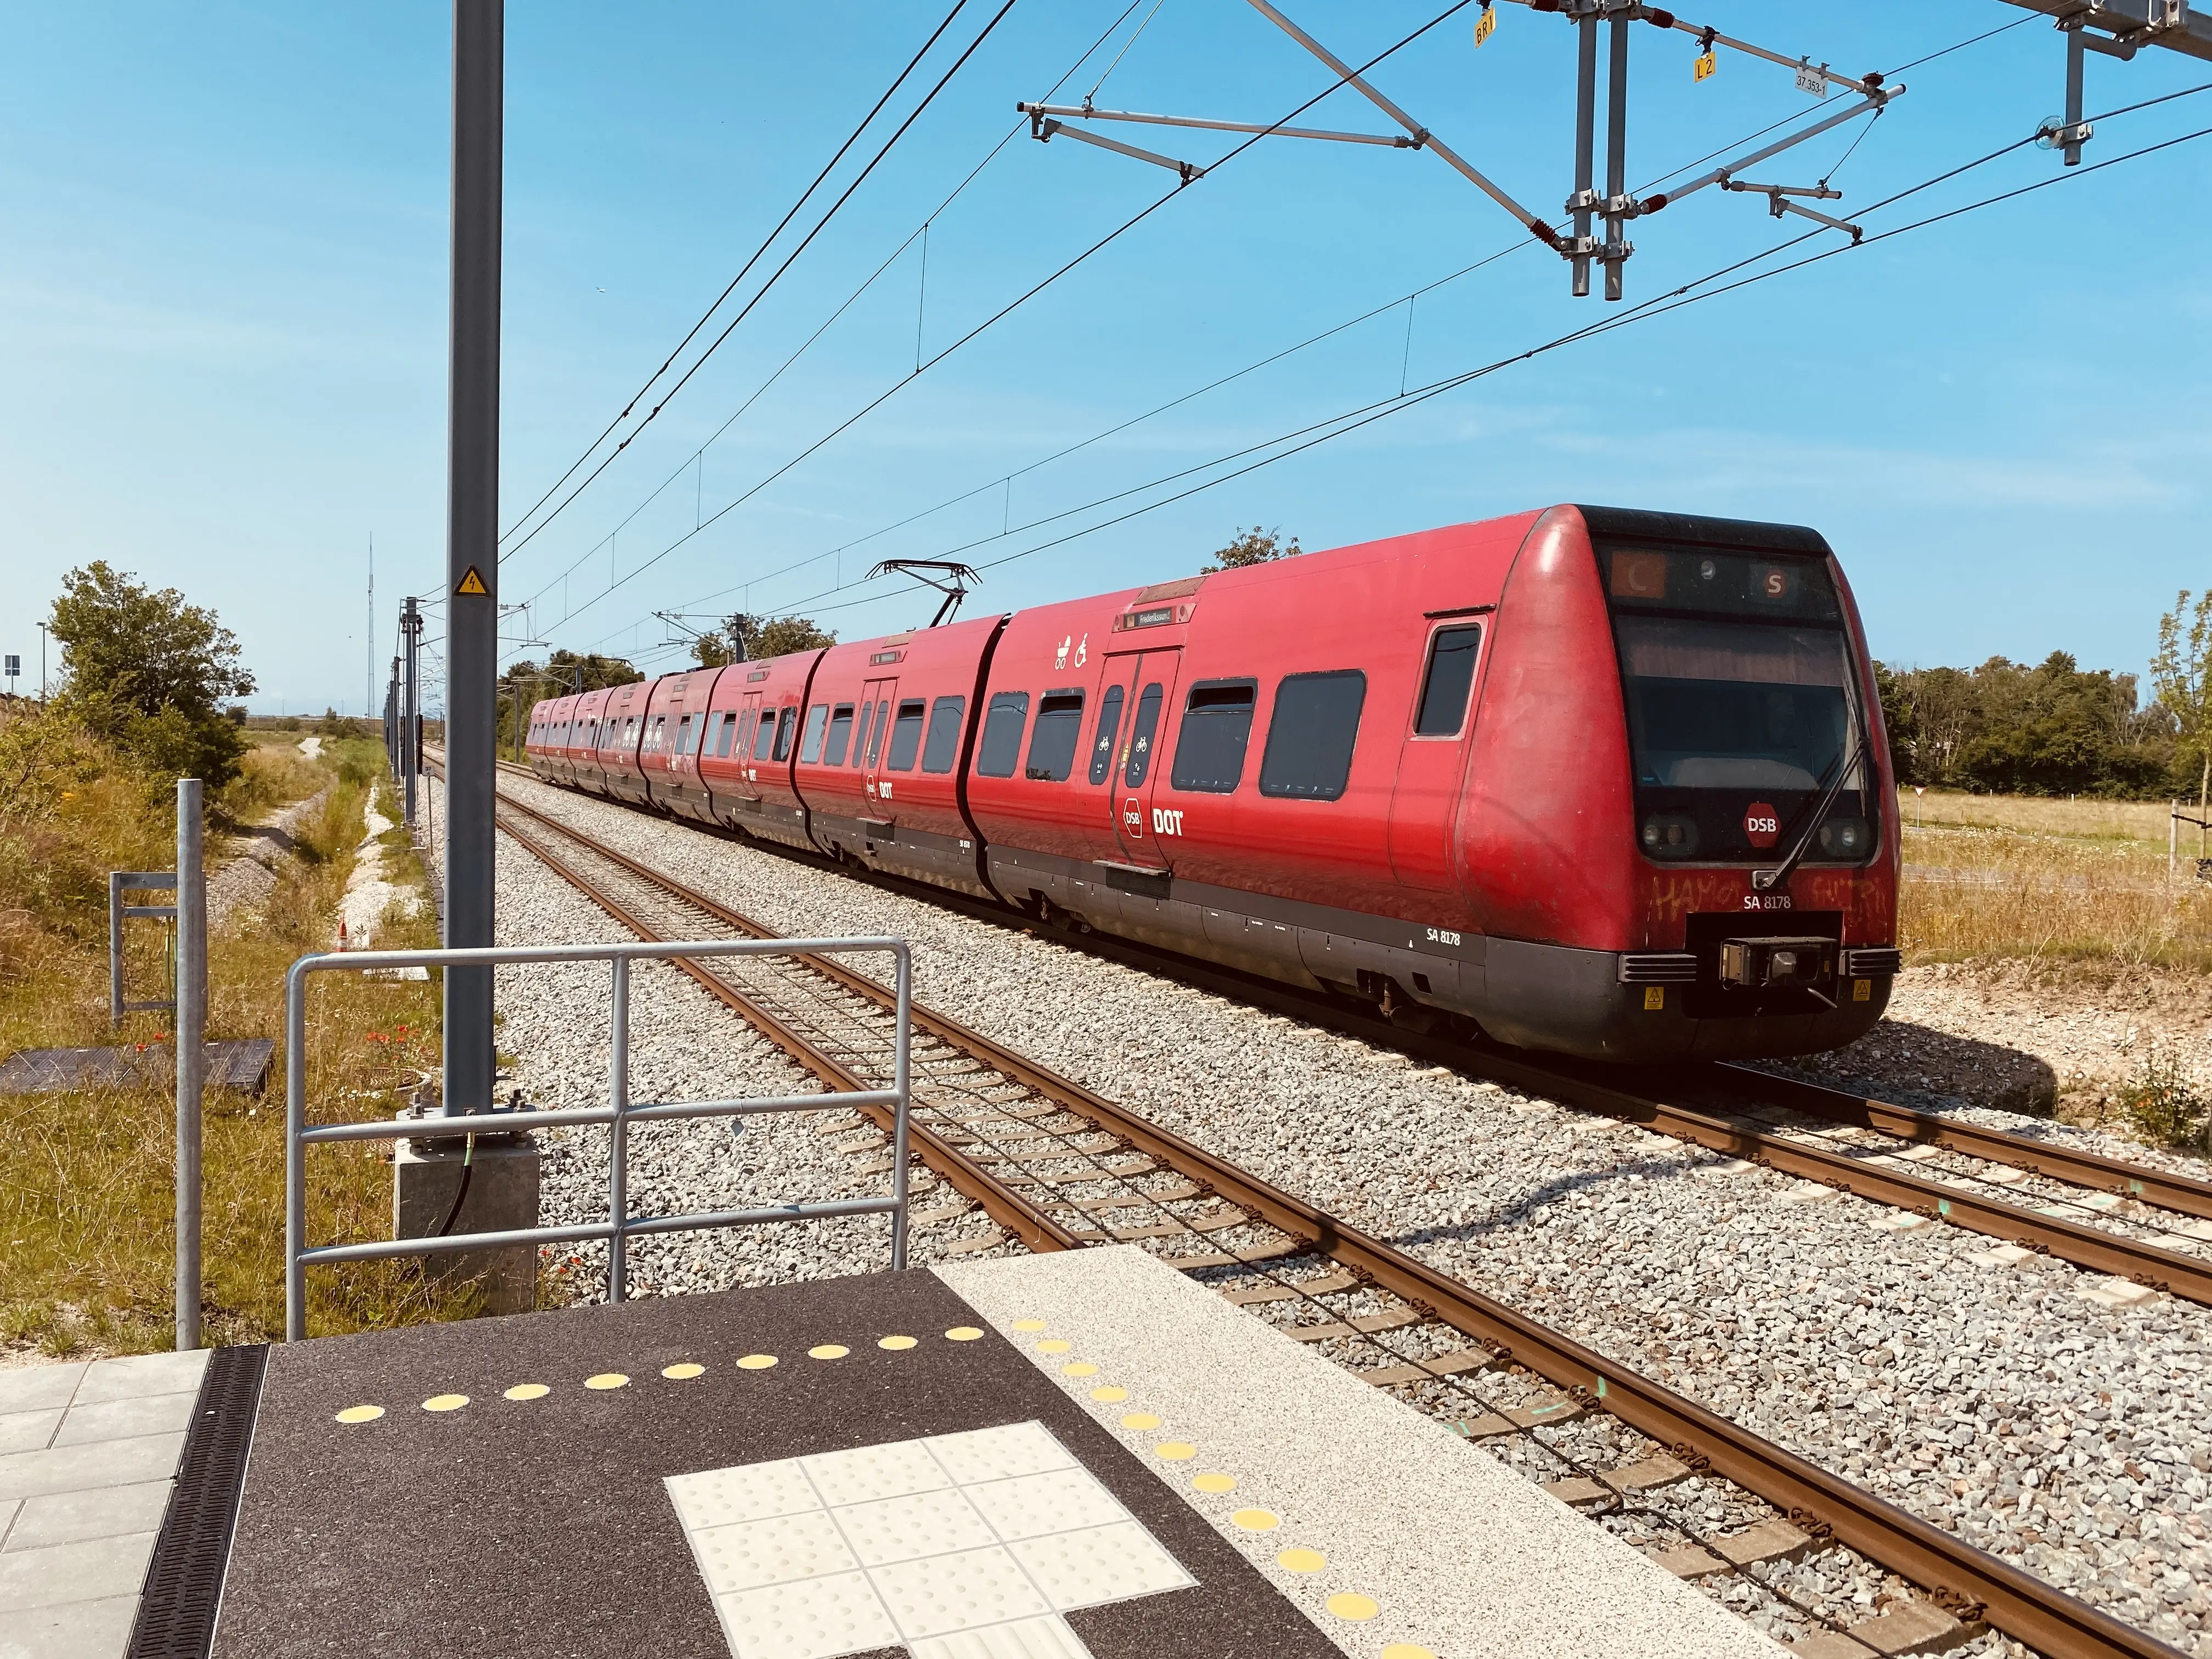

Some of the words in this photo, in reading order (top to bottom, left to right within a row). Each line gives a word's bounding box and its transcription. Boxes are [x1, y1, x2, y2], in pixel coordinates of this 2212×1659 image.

[1797, 75, 1825, 95] 37.353-1
[1768, 574, 1781, 594] S
[879, 781, 893, 799] DOT
[1125, 812, 1140, 824] DSB
[1153, 808, 1183, 836] DOT
[1748, 817, 1776, 832] DSB
[1743, 895, 1761, 910] SA
[1764, 895, 1791, 910] 8178
[1426, 928, 1438, 942] SA
[1440, 930, 1460, 946] 8178
